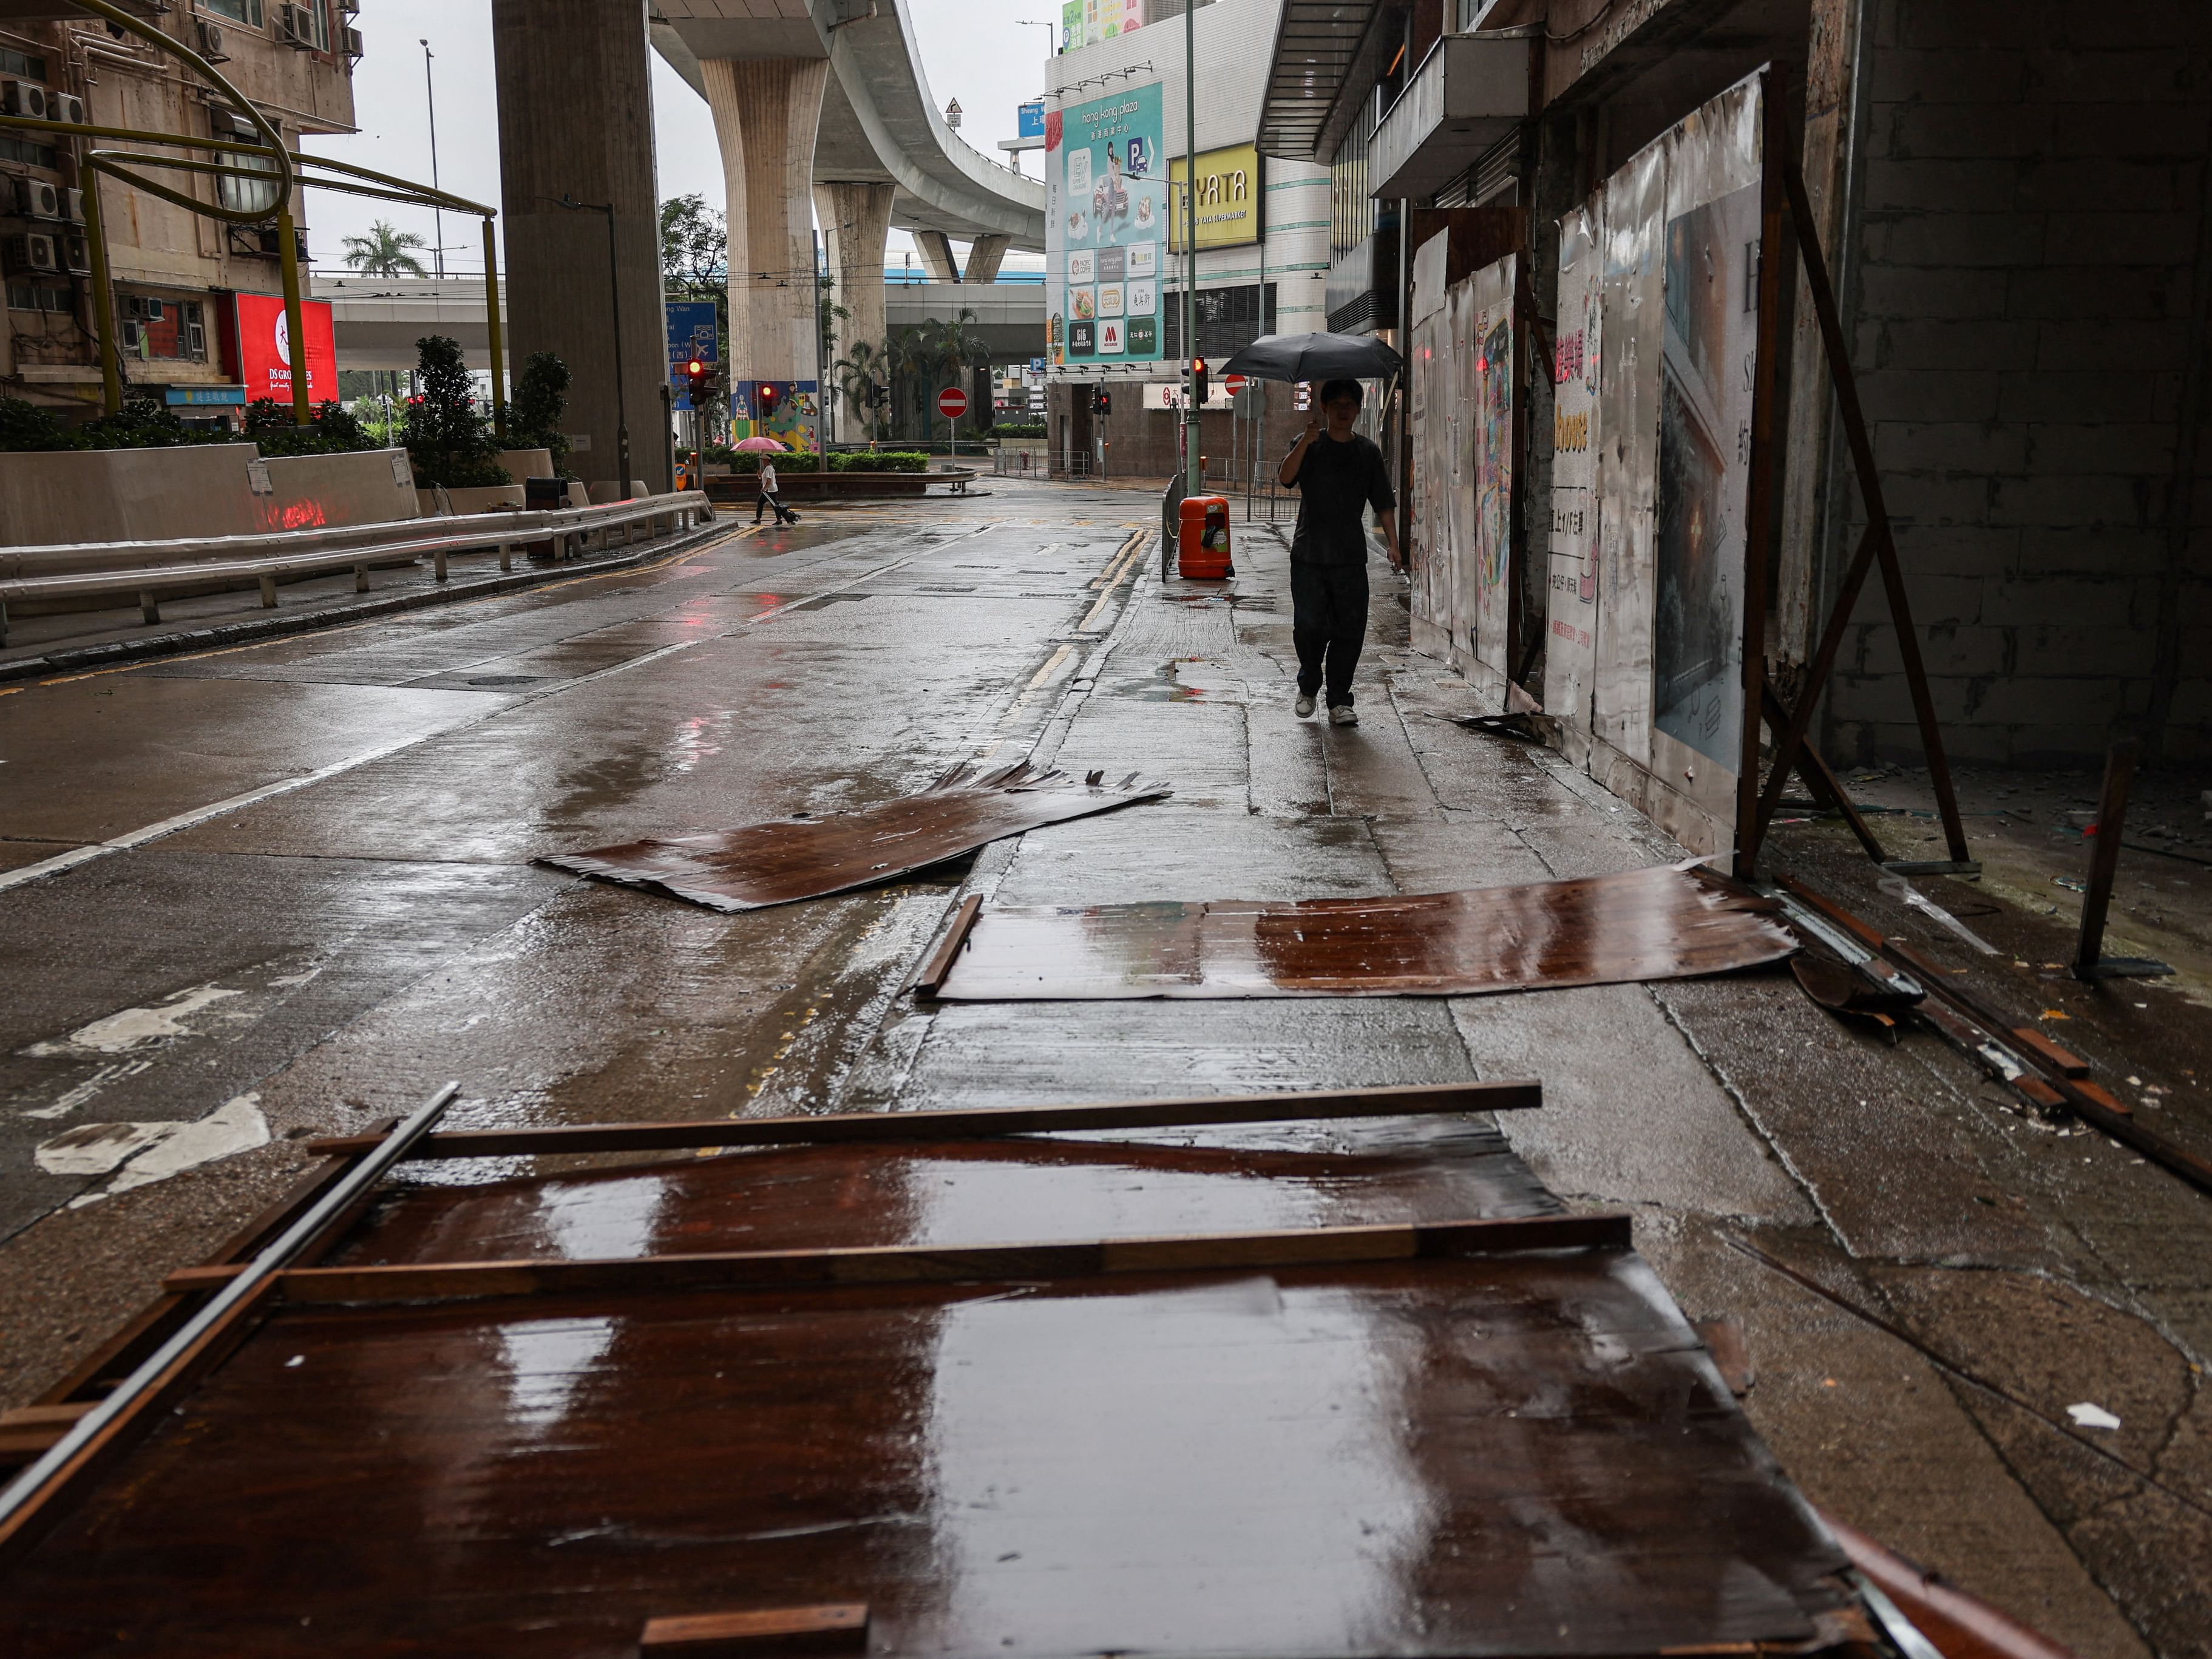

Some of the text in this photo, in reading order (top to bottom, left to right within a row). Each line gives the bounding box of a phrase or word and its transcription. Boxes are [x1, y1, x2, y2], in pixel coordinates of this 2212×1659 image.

[1082, 99, 1138, 127] hong kong plaza
[1091, 123, 1130, 141] 香港商業中心
[1196, 169, 1246, 206] YATA
[1201, 215, 1212, 225] YATA
[1213, 209, 1246, 223] SUPERMARKET
[269, 368, 278, 379] DS
[1556, 404, 1587, 454] house
